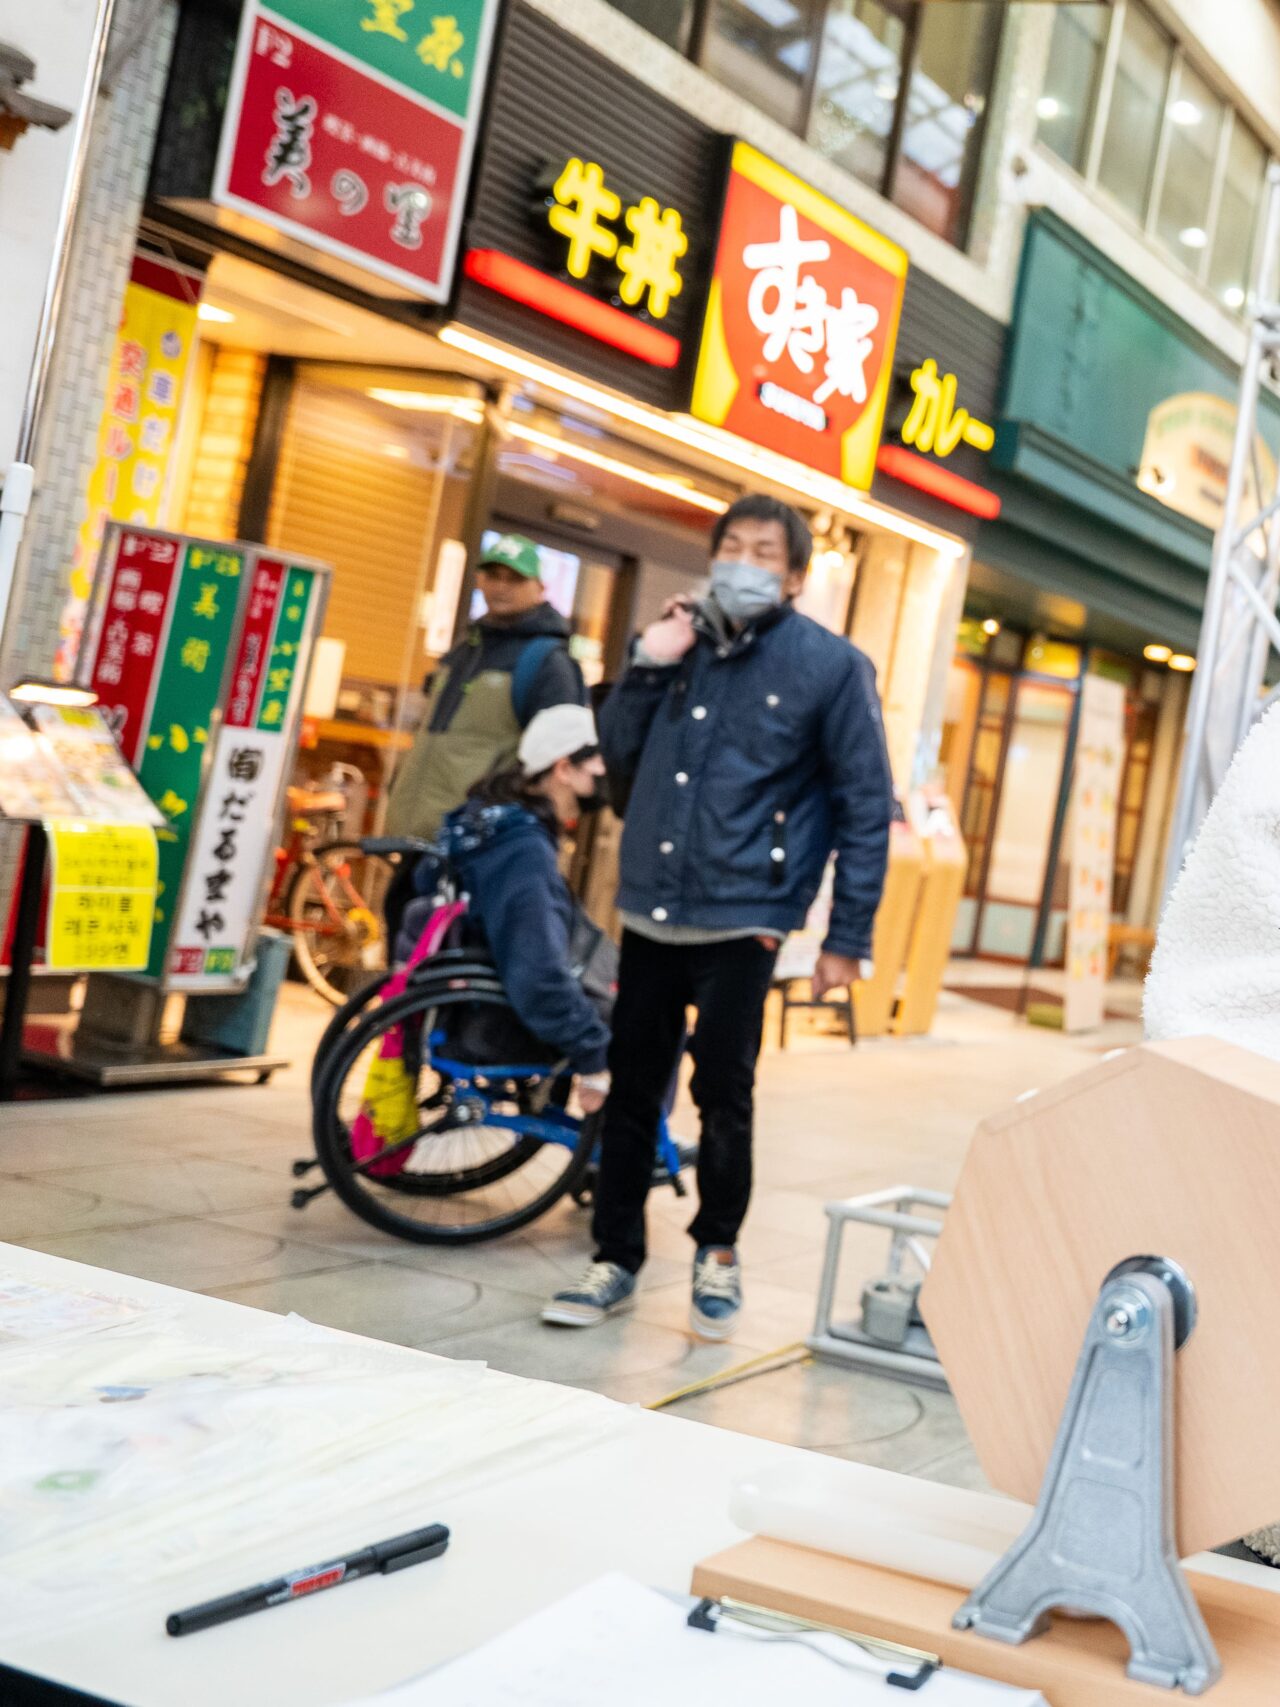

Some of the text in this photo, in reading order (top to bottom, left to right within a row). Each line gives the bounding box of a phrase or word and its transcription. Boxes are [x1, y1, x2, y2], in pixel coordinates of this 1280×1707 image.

[549, 157, 688, 319] 牛丼
[743, 204, 880, 404] すき家
[901, 358, 996, 458] カレー
